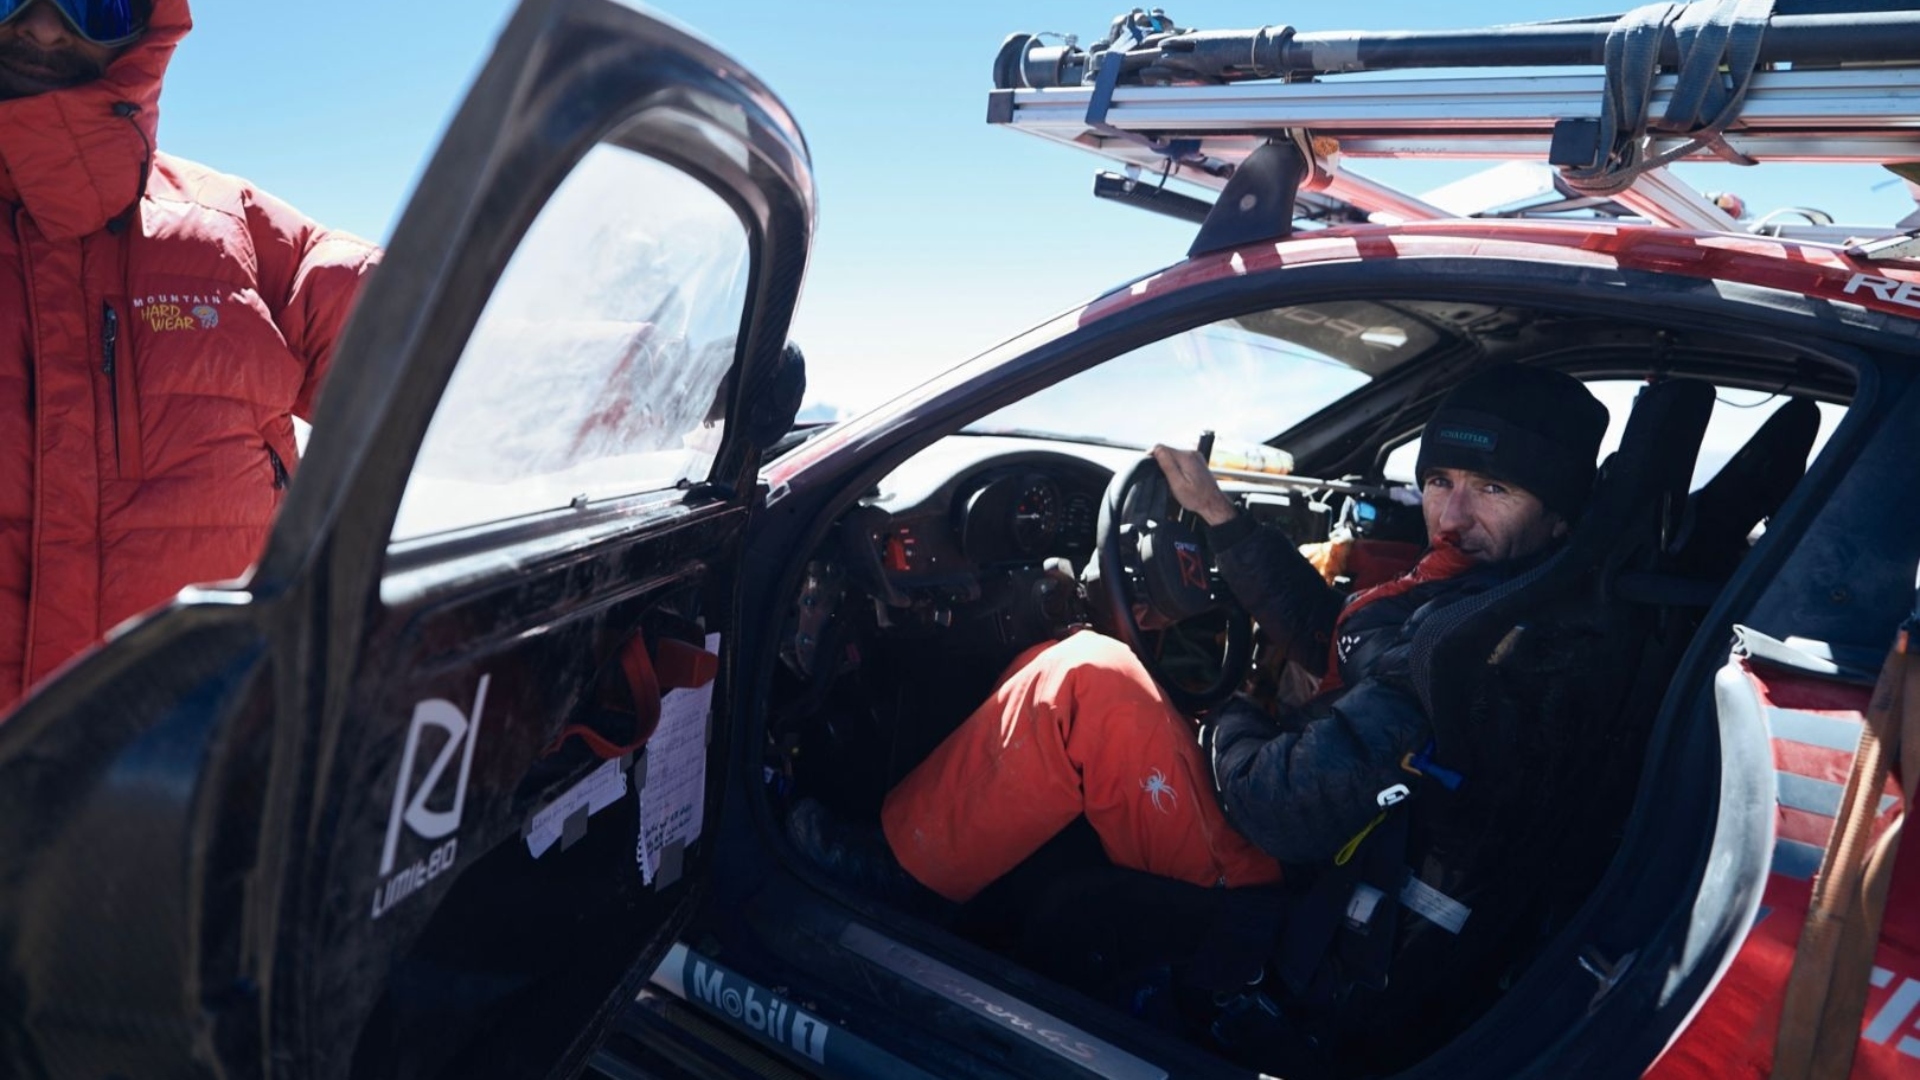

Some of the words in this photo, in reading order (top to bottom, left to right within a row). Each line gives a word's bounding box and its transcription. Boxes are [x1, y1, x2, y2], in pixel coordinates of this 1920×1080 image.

[133, 294, 221, 308] MOUNTAIN
[141, 305, 181, 321] HARD
[151, 317, 195, 332] WEAR
[693, 960, 788, 1043] Mobil
